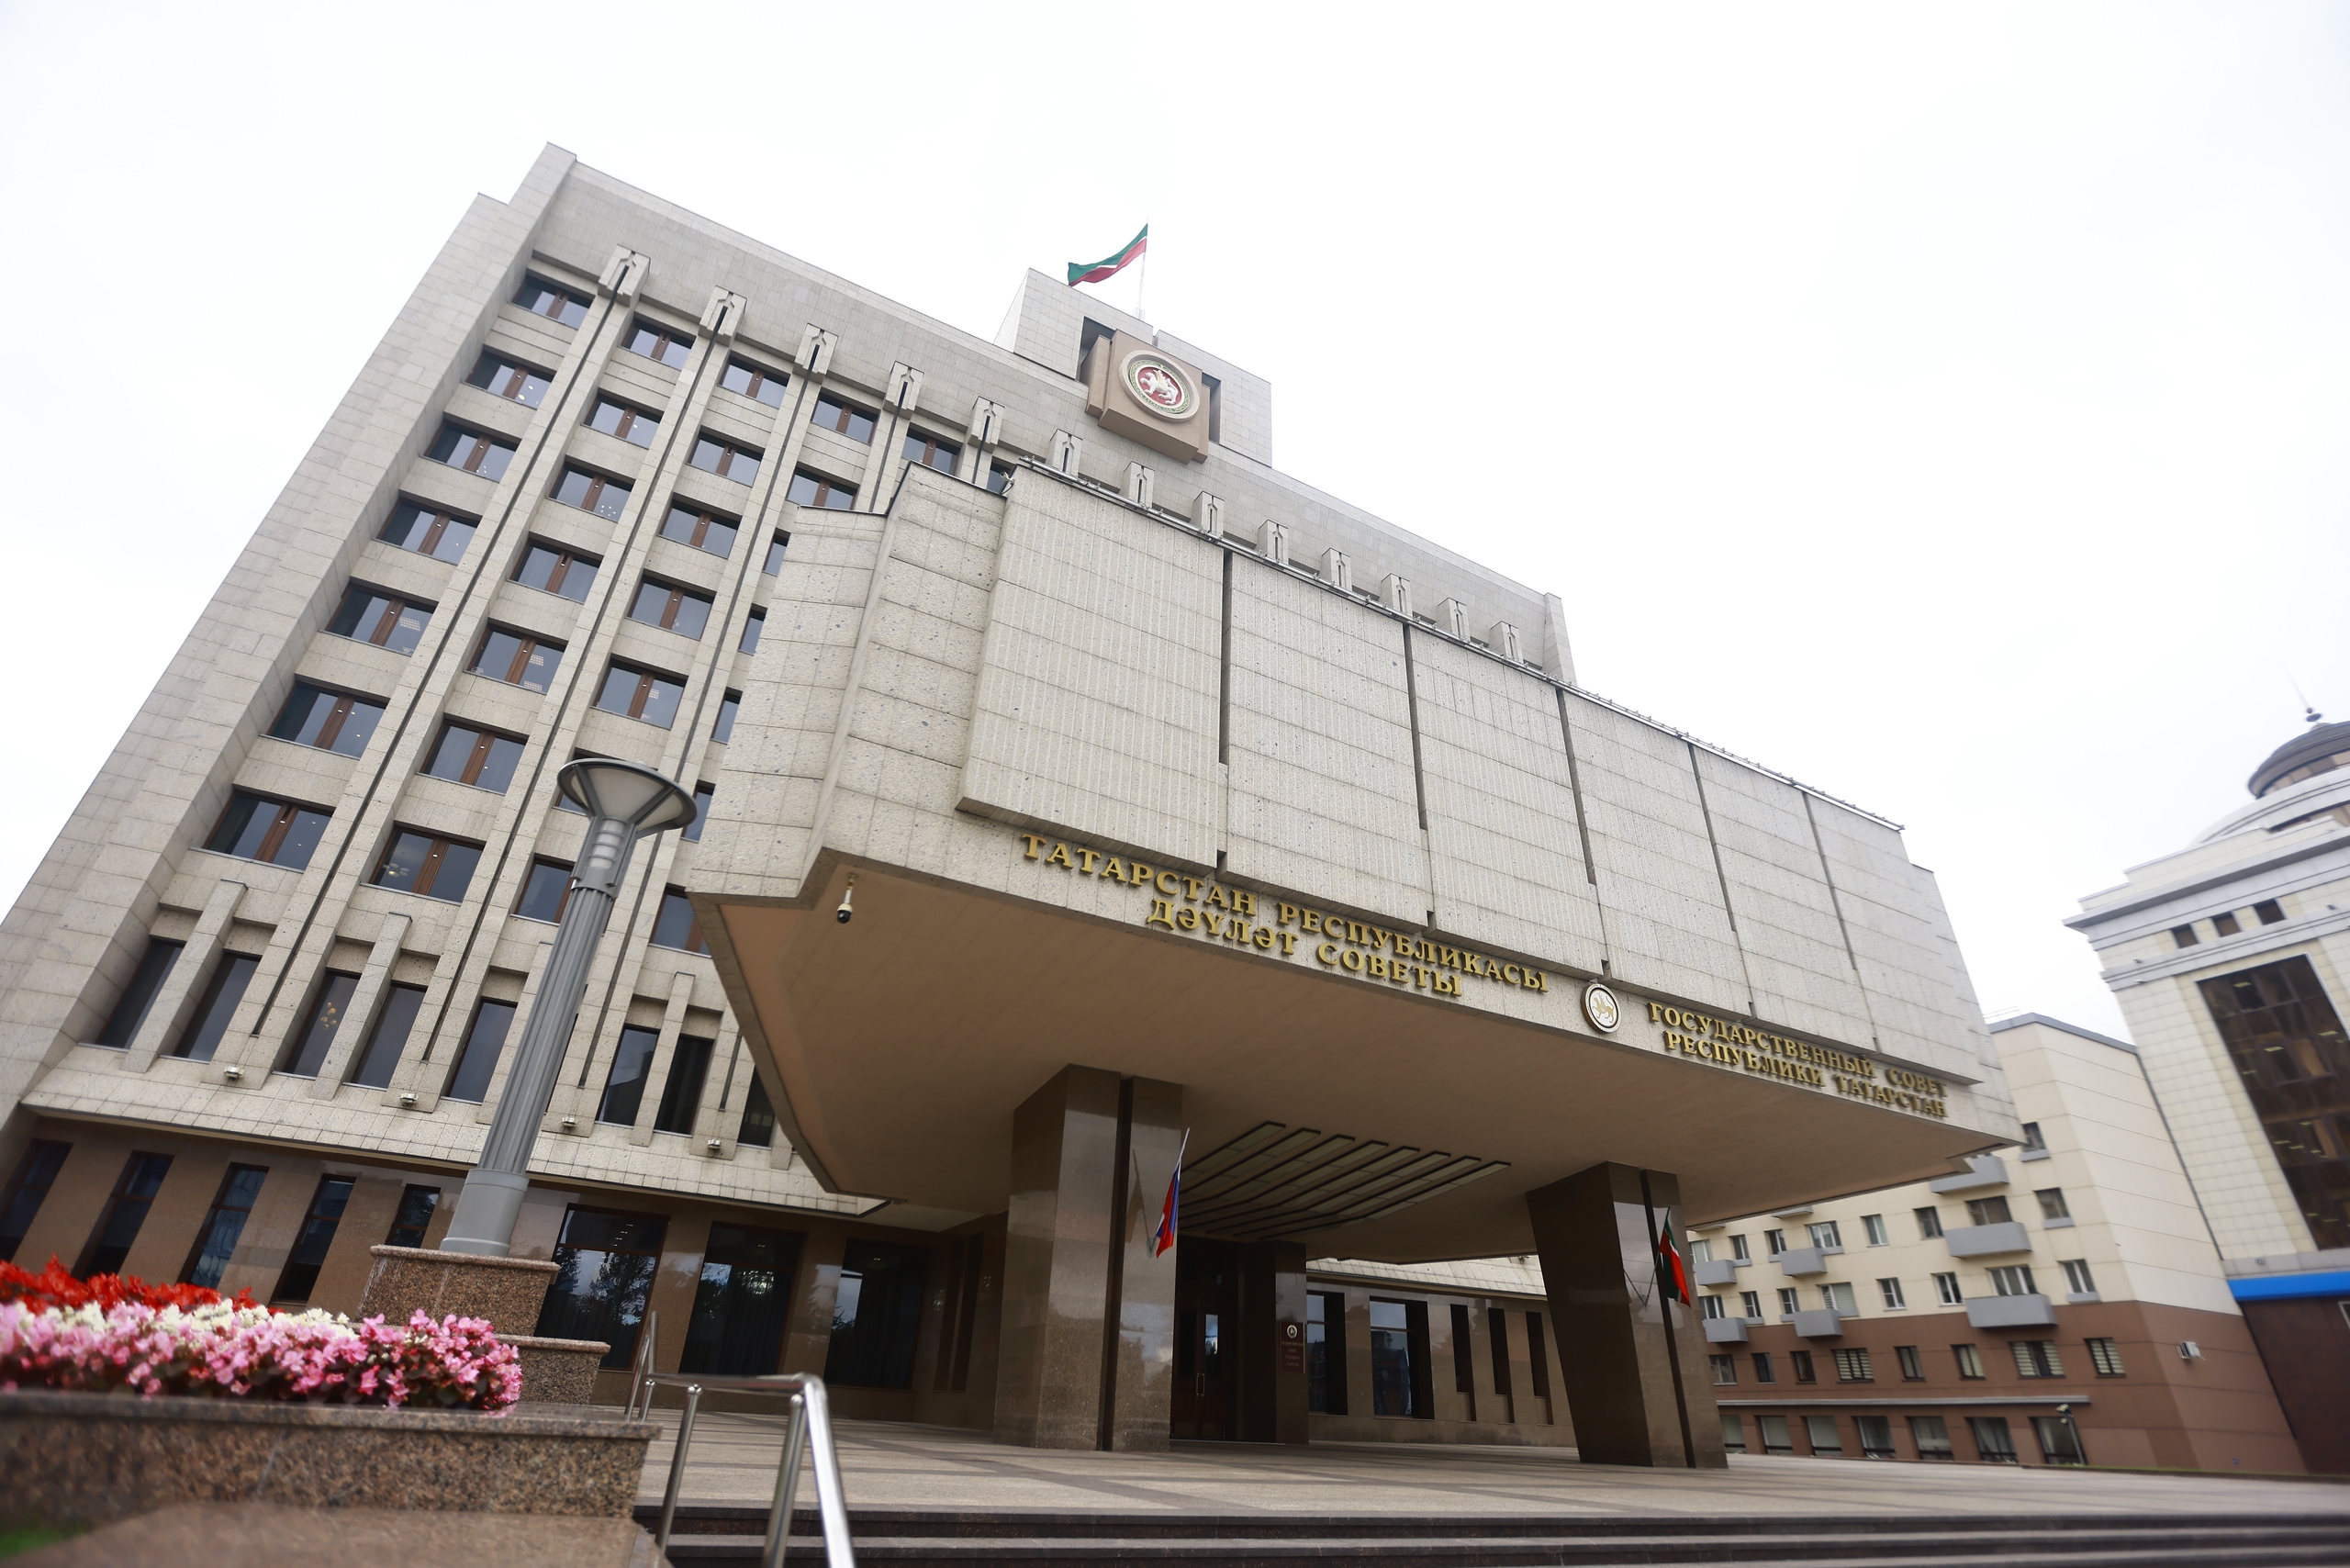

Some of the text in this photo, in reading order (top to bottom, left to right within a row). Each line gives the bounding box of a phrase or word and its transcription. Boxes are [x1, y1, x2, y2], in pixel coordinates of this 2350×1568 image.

[1022, 833, 1549, 993] ТАТАРСТАН РЕСПУБЛИКАСЫ
[1147, 899, 1462, 996] ДӘҮЛӘТ СОВЕТЫ
[1649, 1002, 1948, 1097] ГОСУДАРСТВЕННЫЙ СОВЕТ
[1664, 1031, 1948, 1117] РЕСПУБЛИКИ ТАТАРСТАН
